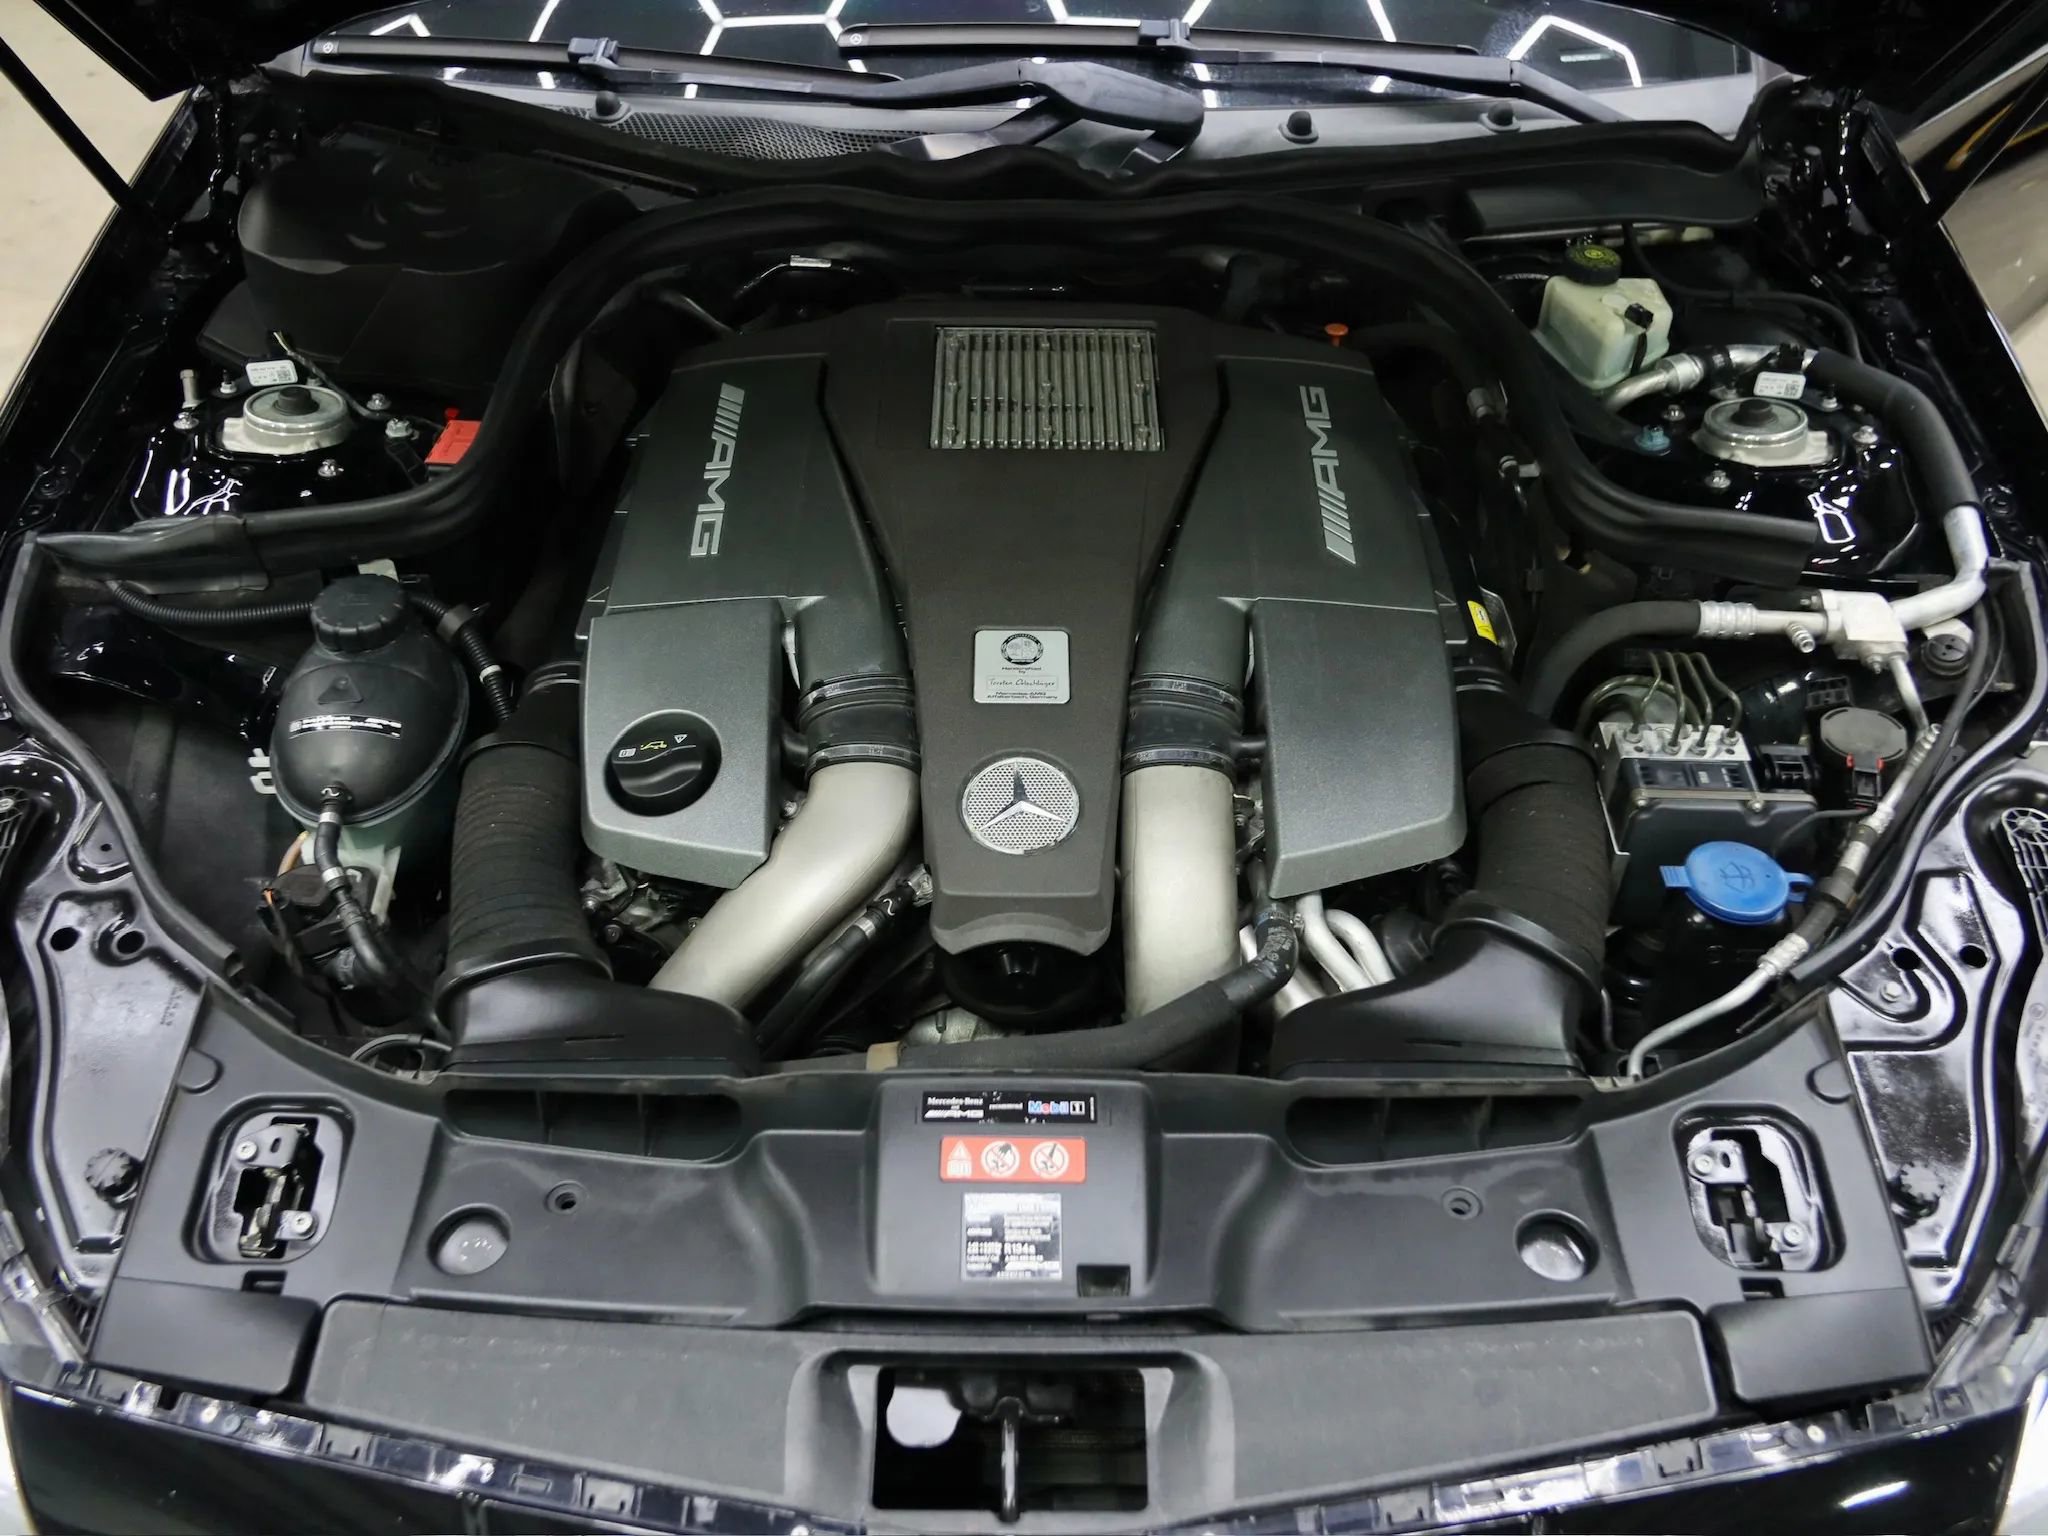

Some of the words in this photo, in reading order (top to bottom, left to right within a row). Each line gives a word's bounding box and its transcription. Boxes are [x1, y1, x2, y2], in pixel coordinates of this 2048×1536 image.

[690, 430, 736, 556] AMG
[927, 1096, 983, 1106] Mercedes-Benz
[1028, 1101, 1069, 1115] Mobil
